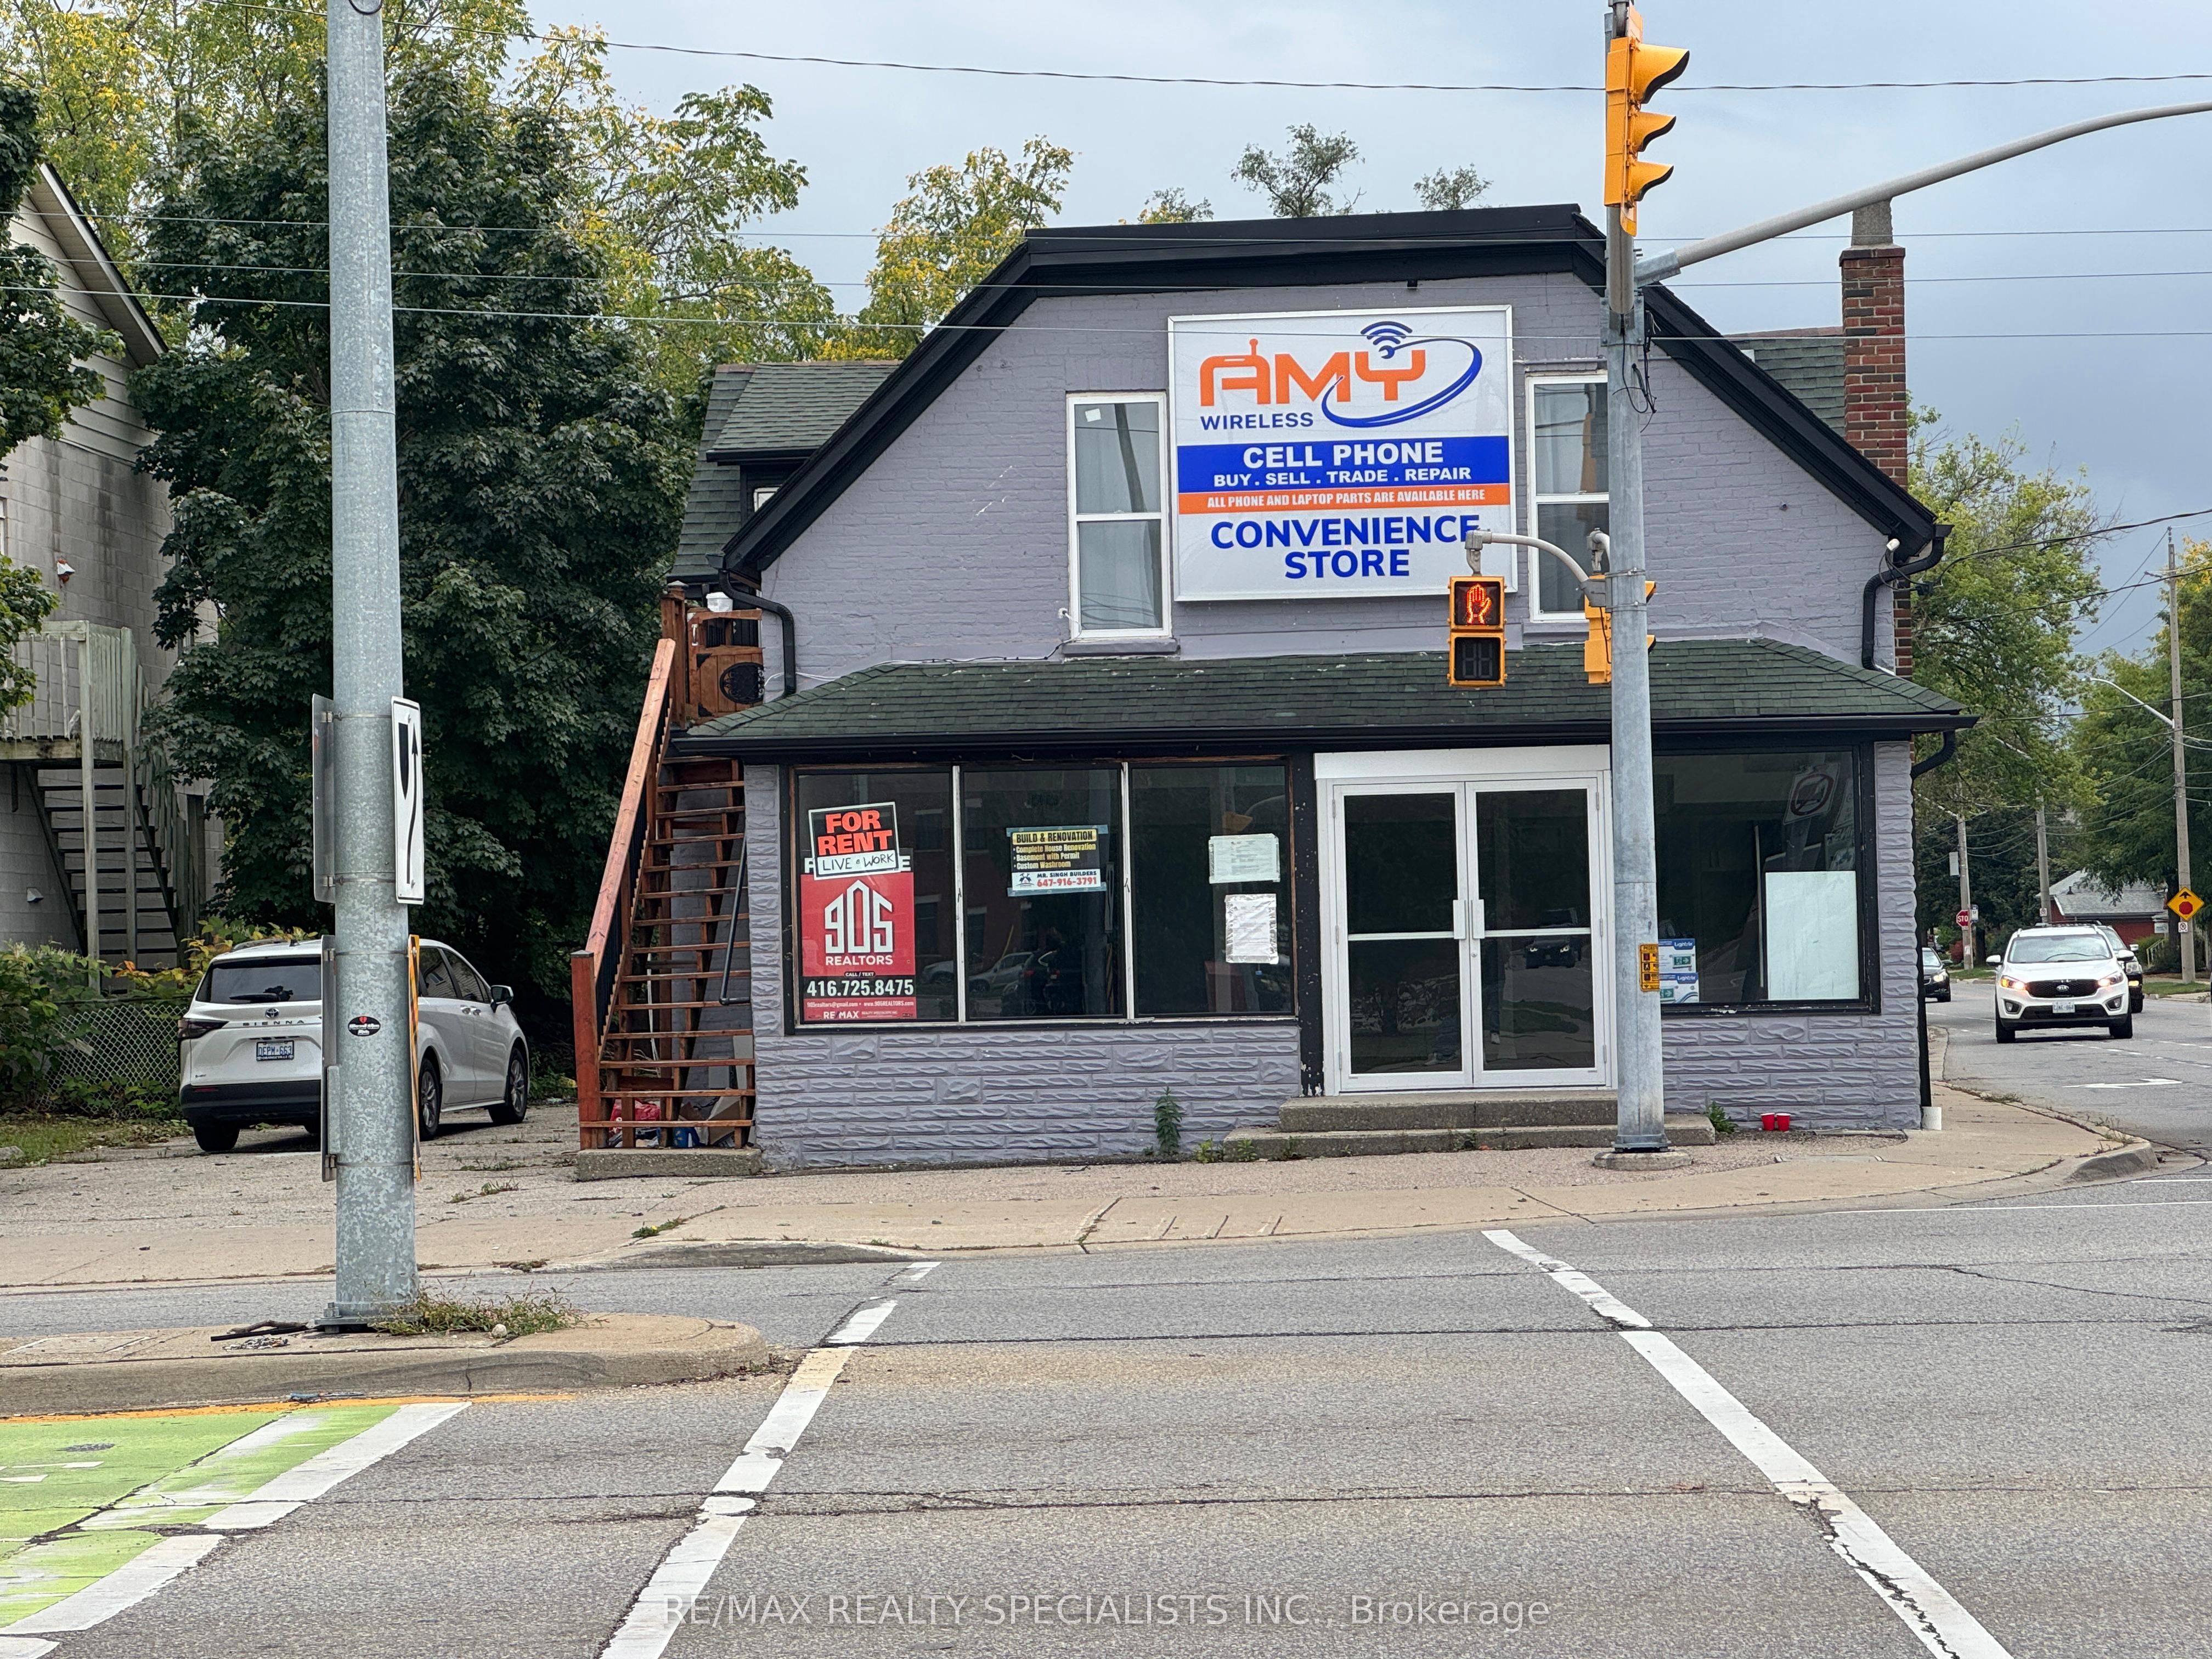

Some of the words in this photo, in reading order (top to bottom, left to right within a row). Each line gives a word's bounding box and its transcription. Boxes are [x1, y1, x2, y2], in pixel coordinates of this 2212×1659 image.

[1200, 338, 1426, 407] AMY
[1200, 413, 1313, 430] WIRELESS
[1243, 445, 1323, 469] CELL
[1333, 442, 1443, 466] PHONE
[1265, 472, 1311, 485] SELL
[1326, 470, 1388, 483] TRADE
[1405, 467, 1471, 481] REPAIR
[1207, 496, 1225, 508] ALL
[1228, 495, 1264, 507] PHONE
[1267, 494, 1289, 506] AND
[1292, 493, 1333, 505] LAPTOP
[1336, 492, 1372, 504] PARTS
[1374, 492, 1395, 503] ARE
[1397, 490, 1455, 502] AVAILABLE
[1458, 489, 1486, 500] HERE
[1211, 515, 1480, 549] CONVENIENCE
[1285, 550, 1409, 579] STORE
[826, 810, 881, 833] FOR
[817, 830, 893, 855] RENT
[1017, 834, 1037, 843] BUILD
[1040, 833, 1045, 842] &
[1048, 831, 1093, 842] RENOVATION
[1064, 843, 1096, 851] Renovation
[823, 857, 852, 871] LIVE
[864, 853, 894, 867] WORK
[1037, 877, 1097, 887] 647-916-3791
[825, 879, 893, 954] 905
[826, 955, 893, 966] REALTORS
[806, 979, 914, 996] 416.725.8475
[823, 1011, 859, 1019] RE/MAX
